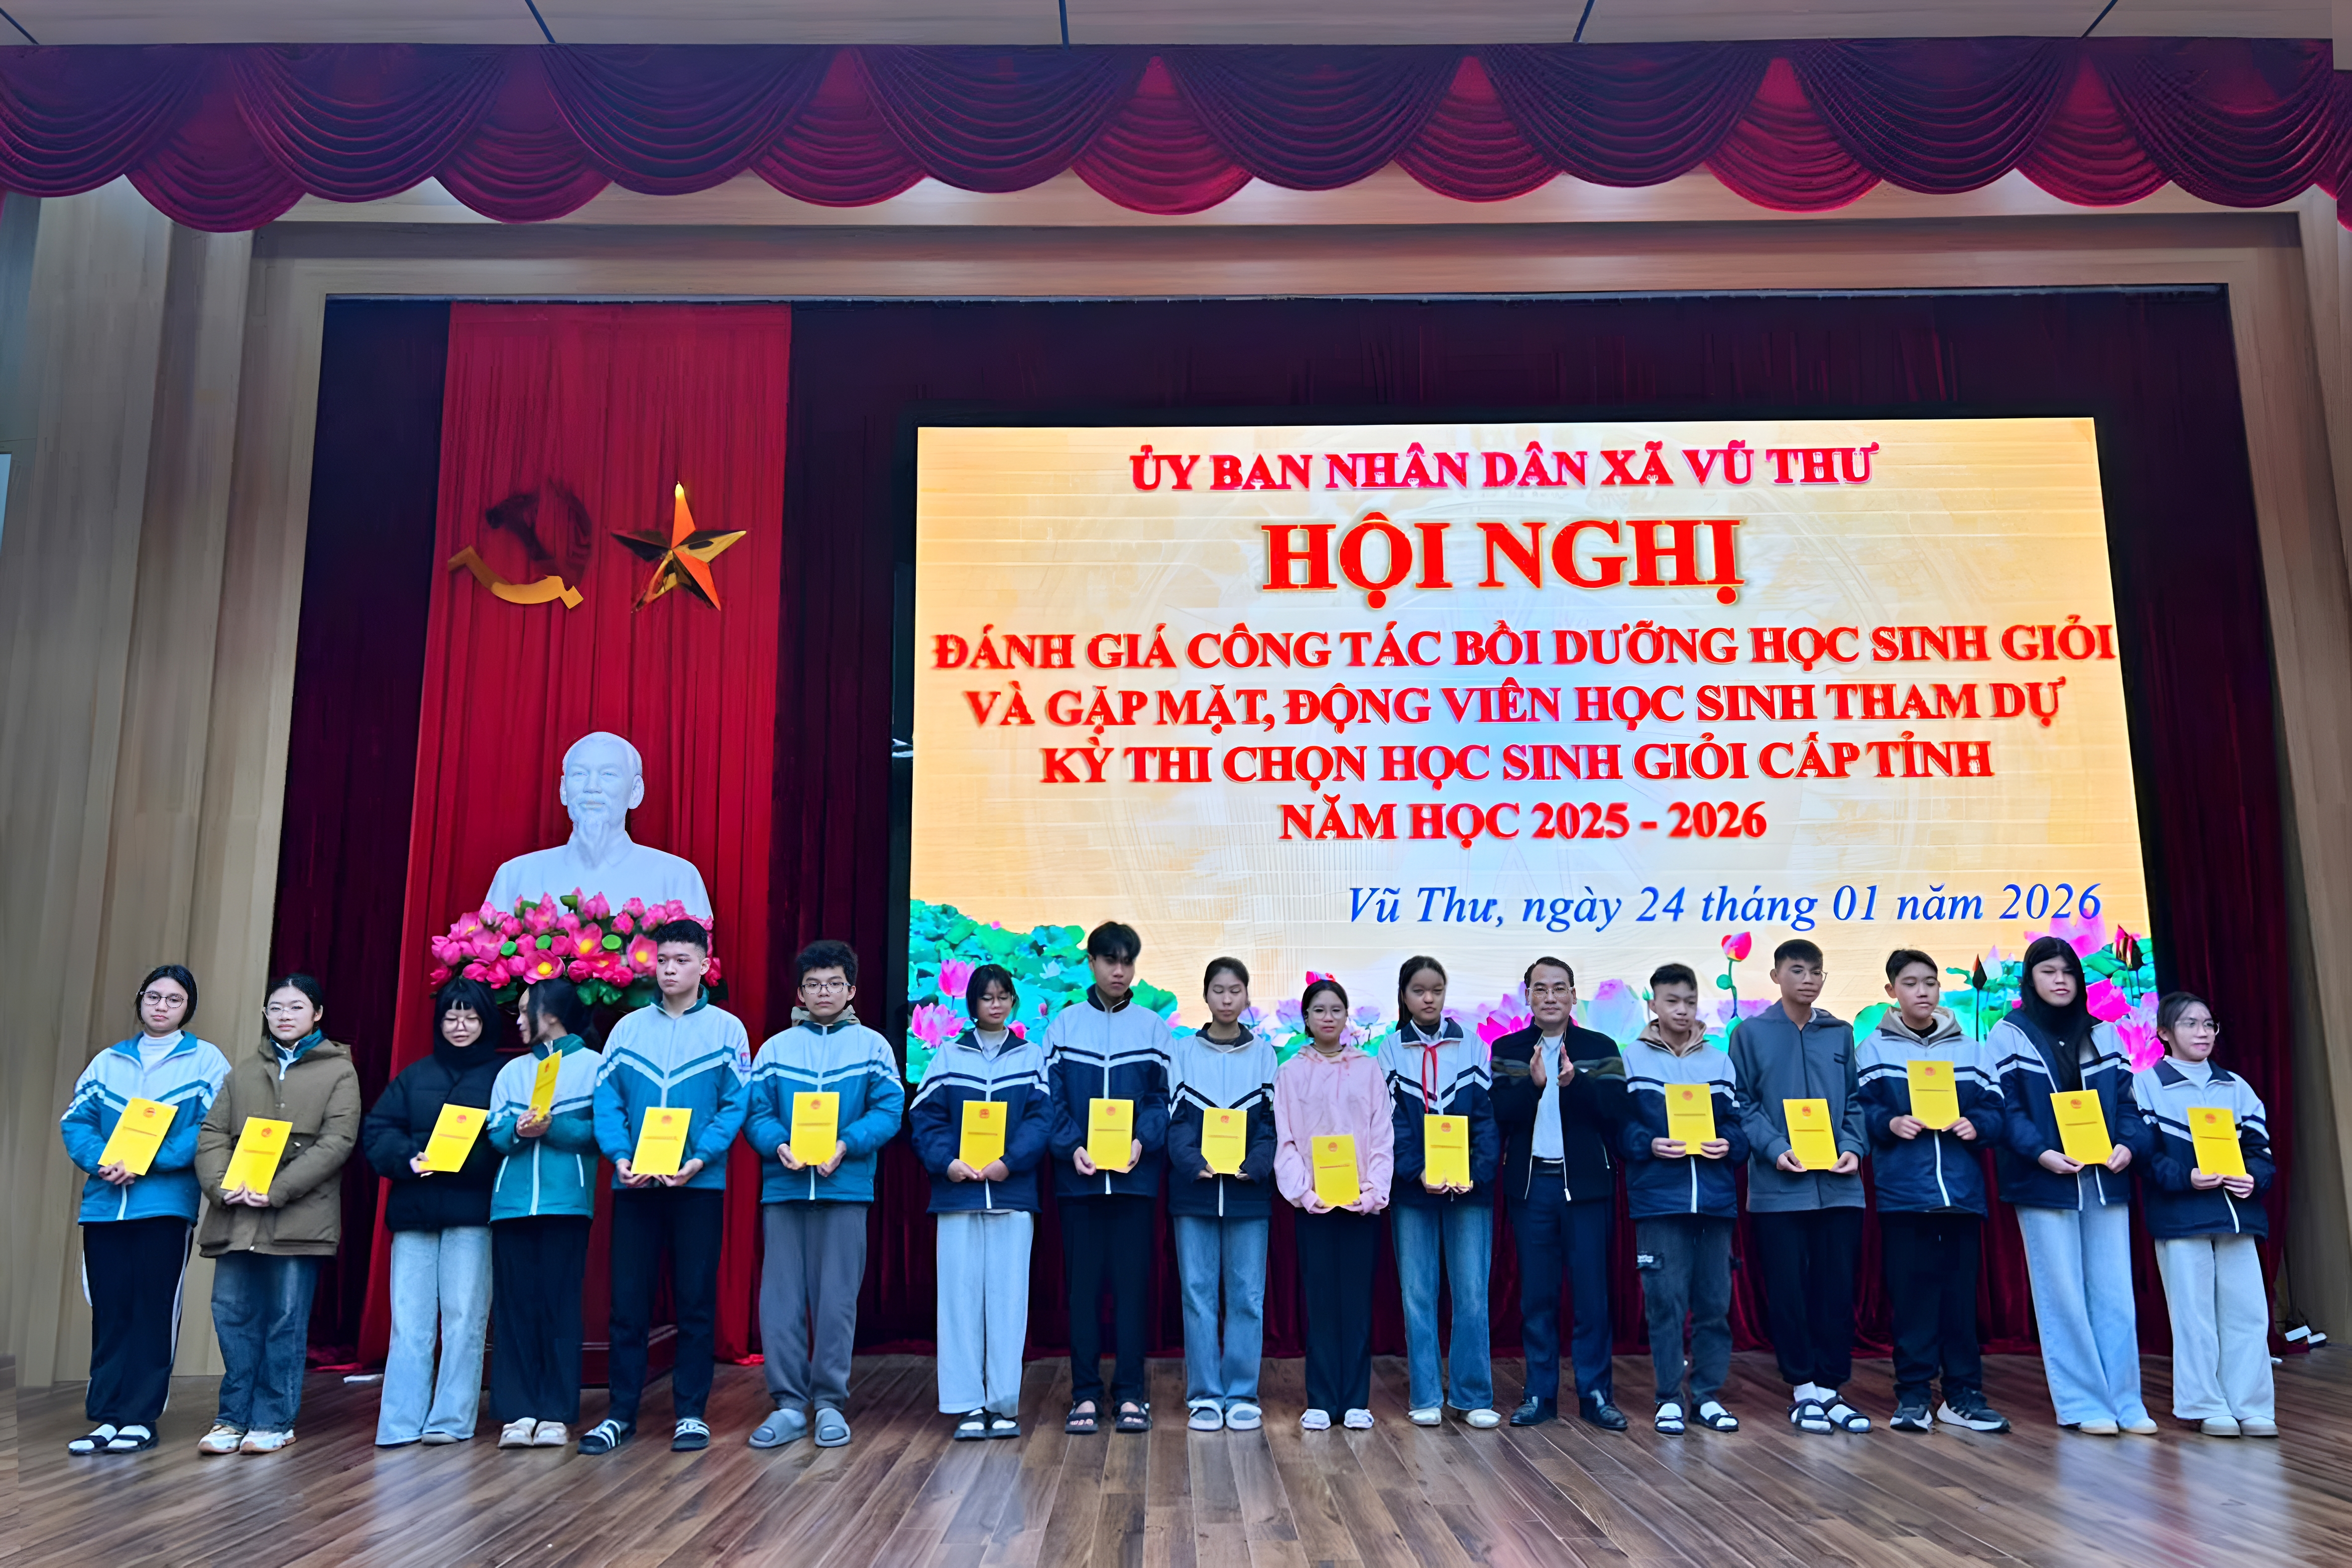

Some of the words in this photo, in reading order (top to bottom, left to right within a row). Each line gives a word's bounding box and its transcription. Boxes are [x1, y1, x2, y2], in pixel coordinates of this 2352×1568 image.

[1129, 444, 1201, 491] ỦY
[1209, 453, 1313, 491] BAN
[1324, 442, 1470, 489] NHÂN
[1480, 440, 1588, 488] DÂN
[1600, 440, 1674, 486] XÃ
[1681, 439, 1755, 486] VŨ
[1765, 441, 1880, 485] THƯ
[1261, 511, 1453, 609] HỘI
[1476, 519, 1745, 605] NGHỊ
[934, 623, 1076, 670] ĐÁNH
[1086, 622, 1177, 669] GIÁ
[1186, 622, 1332, 669] CÔNG
[1339, 620, 1441, 667] TÁC
[1453, 619, 1542, 666] BỒI
[1552, 619, 1739, 666] DƯỠNG
[1749, 626, 1860, 672] HỌC
[1871, 625, 1992, 662] SINH
[2000, 614, 2116, 662] GIỎI
[965, 680, 1036, 726] VÀ
[1047, 685, 1149, 736] GẶP
[1155, 684, 1276, 735] MẶT,
[1283, 682, 1432, 735] ĐỘNG
[1440, 676, 1562, 723] VIÊN
[1573, 685, 1685, 732] HỌC
[1696, 684, 1818, 721] SINH
[1825, 683, 1982, 720] THAM
[1988, 675, 2067, 728] DỰ
[1040, 736, 1115, 784] KỲ
[1123, 746, 1213, 784] THI
[1222, 745, 1368, 792] CHỌN
[1379, 744, 1490, 791] HỌC
[1502, 743, 1624, 782] SINH
[1633, 731, 1750, 780] GIỎI
[1759, 731, 1861, 779] CẤP
[1866, 730, 1995, 779] TỈNH
[1279, 793, 1399, 840] NĂM
[1408, 802, 1521, 849] HỌC
[1531, 801, 1630, 840] 2025
[1640, 821, 1658, 830] -
[1667, 800, 1767, 838] 2026
[1349, 887, 1401, 923] Vũ
[1416, 886, 1504, 928] Thư,
[1522, 886, 1622, 933] ngày
[1635, 886, 1685, 922] 24
[1701, 885, 1819, 932] tháng
[1833, 885, 1878, 921] 01
[1896, 884, 1984, 921] năm
[1999, 883, 2101, 920] 2026
